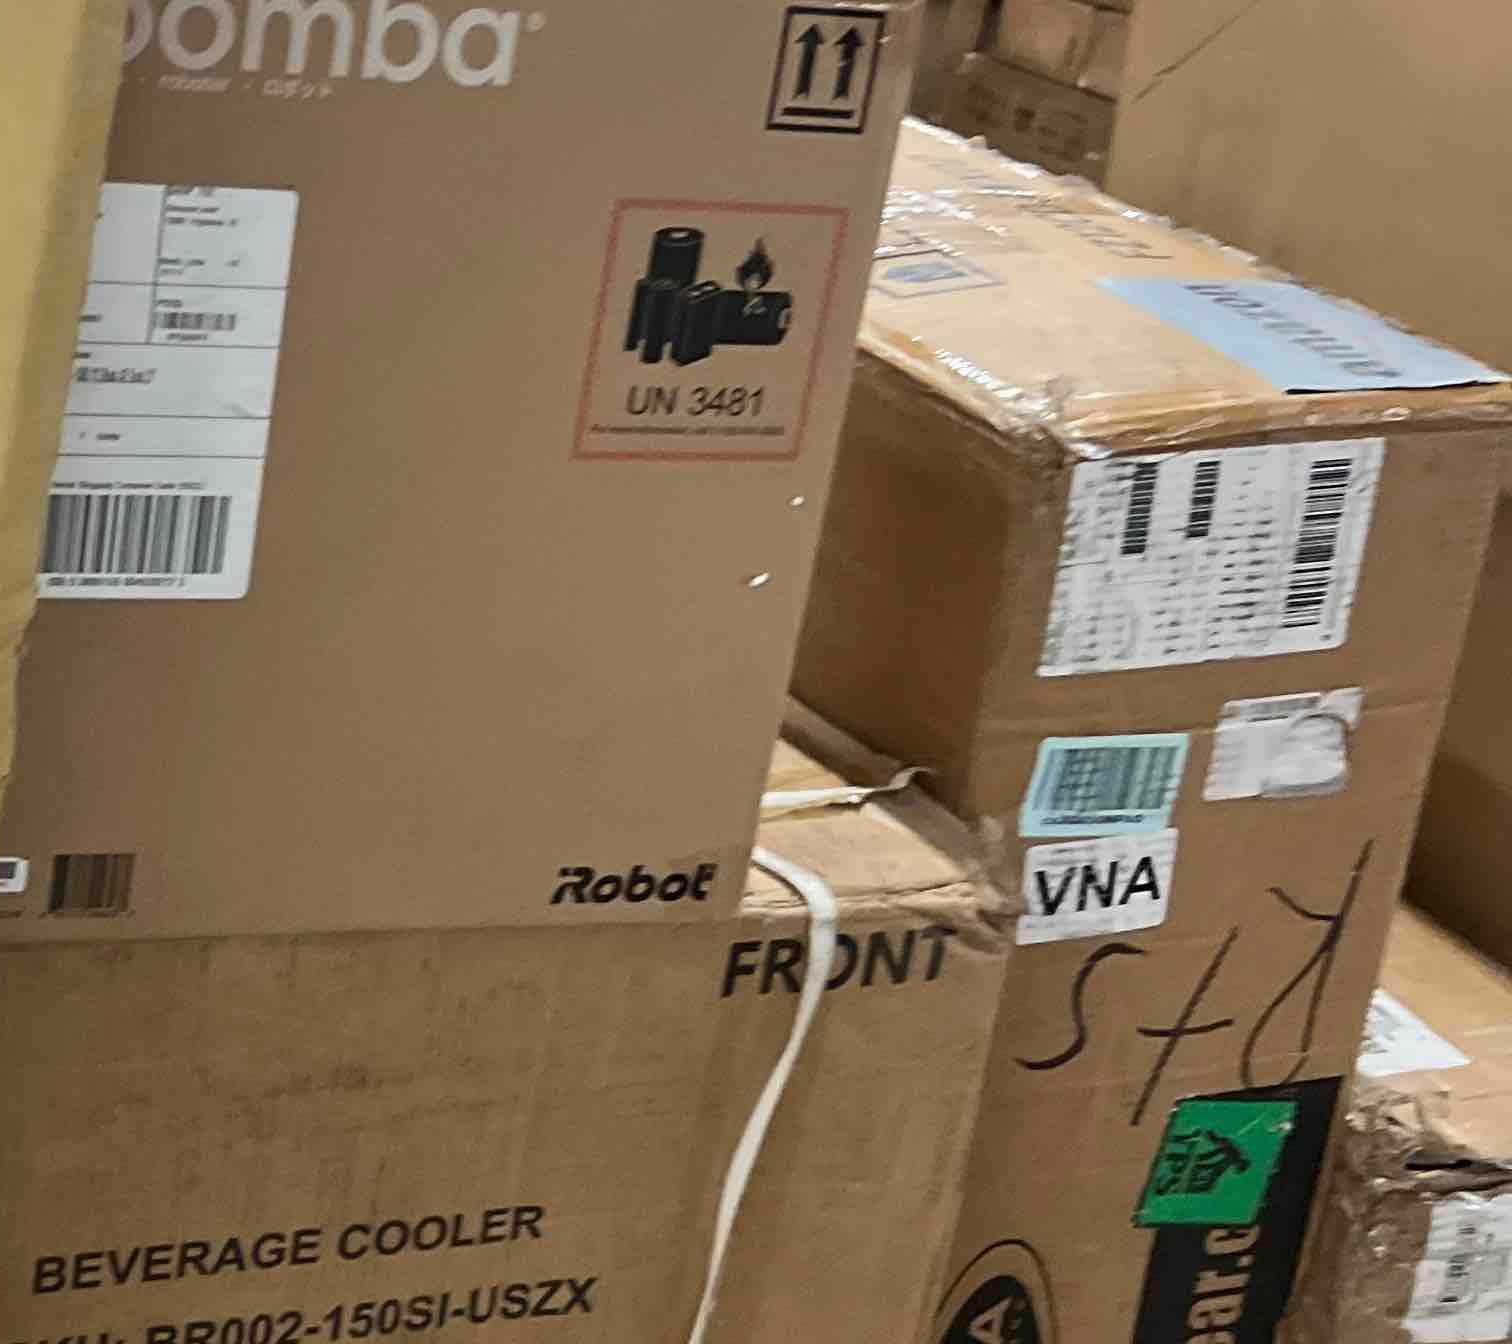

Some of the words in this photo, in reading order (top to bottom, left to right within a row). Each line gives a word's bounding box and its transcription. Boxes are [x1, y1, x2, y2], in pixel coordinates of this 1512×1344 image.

[626, 384, 681, 416] UN
[685, 385, 765, 417] 3481
[1034, 856, 1160, 917] VNA
[31, 1228, 321, 1296] BEVERAGE
[337, 1204, 545, 1263] COOLER
